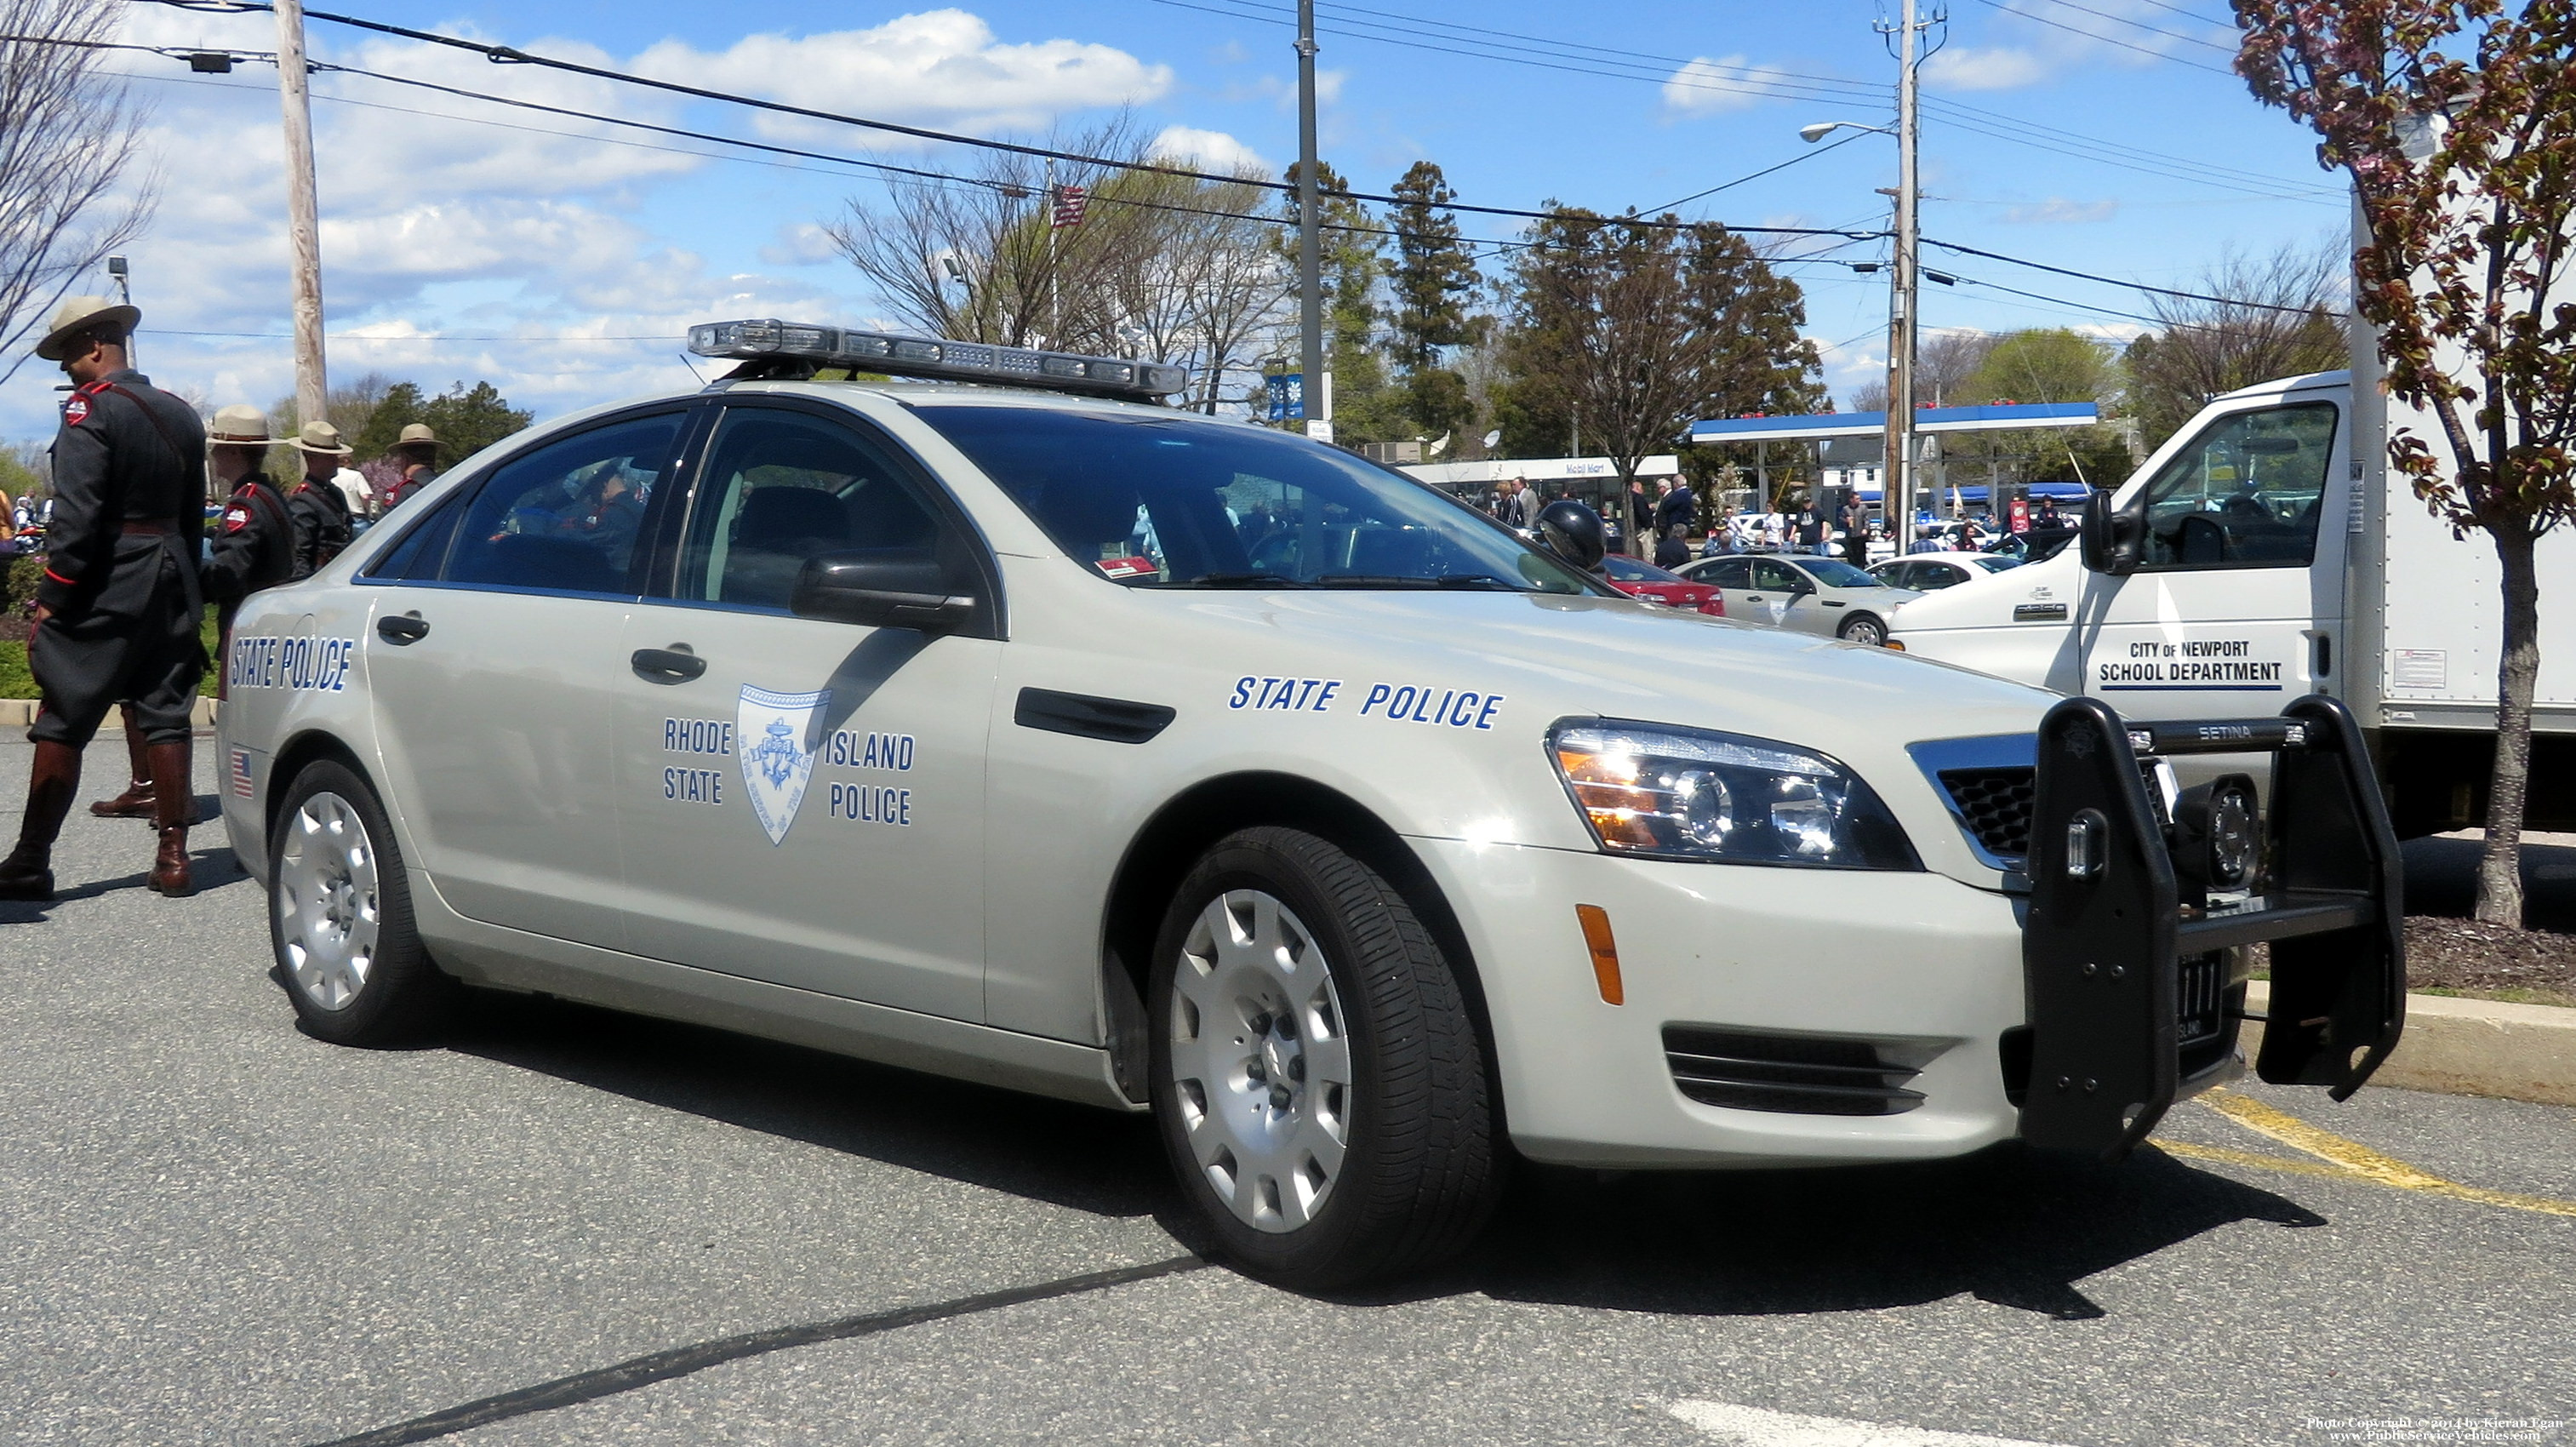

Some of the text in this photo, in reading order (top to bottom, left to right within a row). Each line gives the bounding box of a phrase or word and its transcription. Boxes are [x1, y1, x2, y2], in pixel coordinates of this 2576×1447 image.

[232, 634, 354, 694] STATE POLICE
[2099, 662, 2282, 681] SCHOOL DEPARTMENT
[2130, 641, 2249, 658] CITY OF NEWPORT
[1228, 674, 1507, 731] STATE POLICE
[664, 717, 734, 756] RHODE
[824, 730, 916, 772] ISLAND
[2198, 725, 2252, 740] SETINA
[664, 766, 912, 827] STATE POLICE
